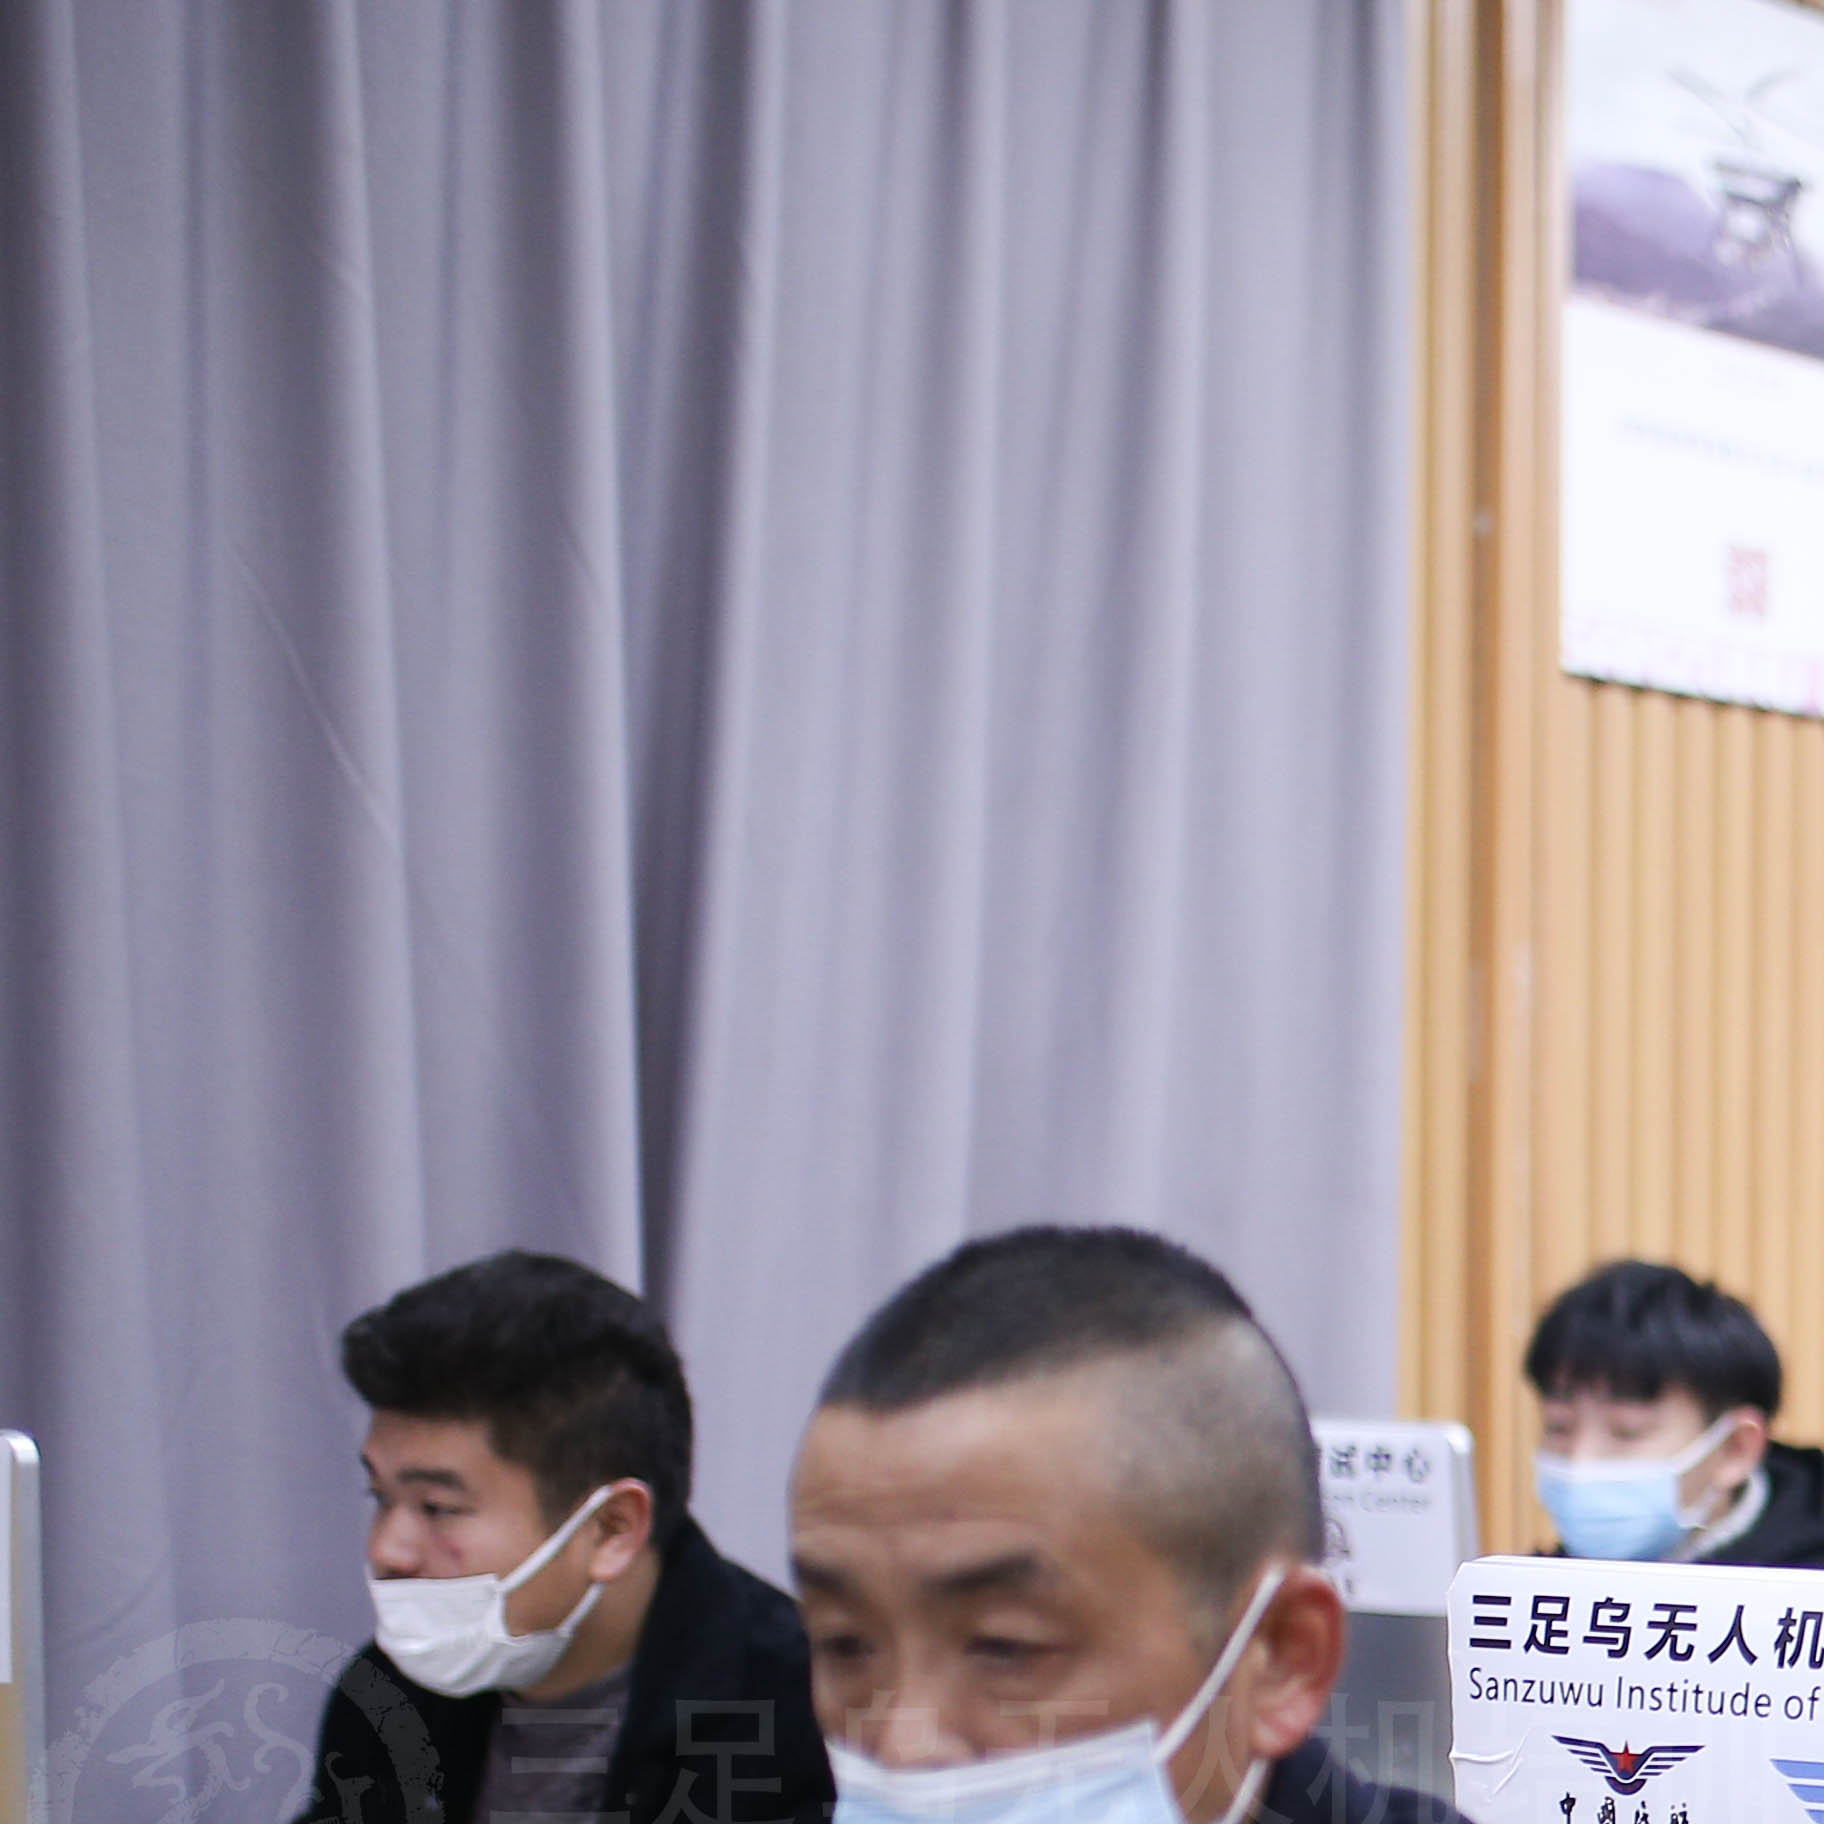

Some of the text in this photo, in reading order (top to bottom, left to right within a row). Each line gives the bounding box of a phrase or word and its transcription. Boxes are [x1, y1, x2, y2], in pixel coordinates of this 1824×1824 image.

[1468, 1666, 1604, 1709] Sanzuwu
[1616, 1676, 1772, 1720] Institude
[1783, 1684, 1821, 1723] of
